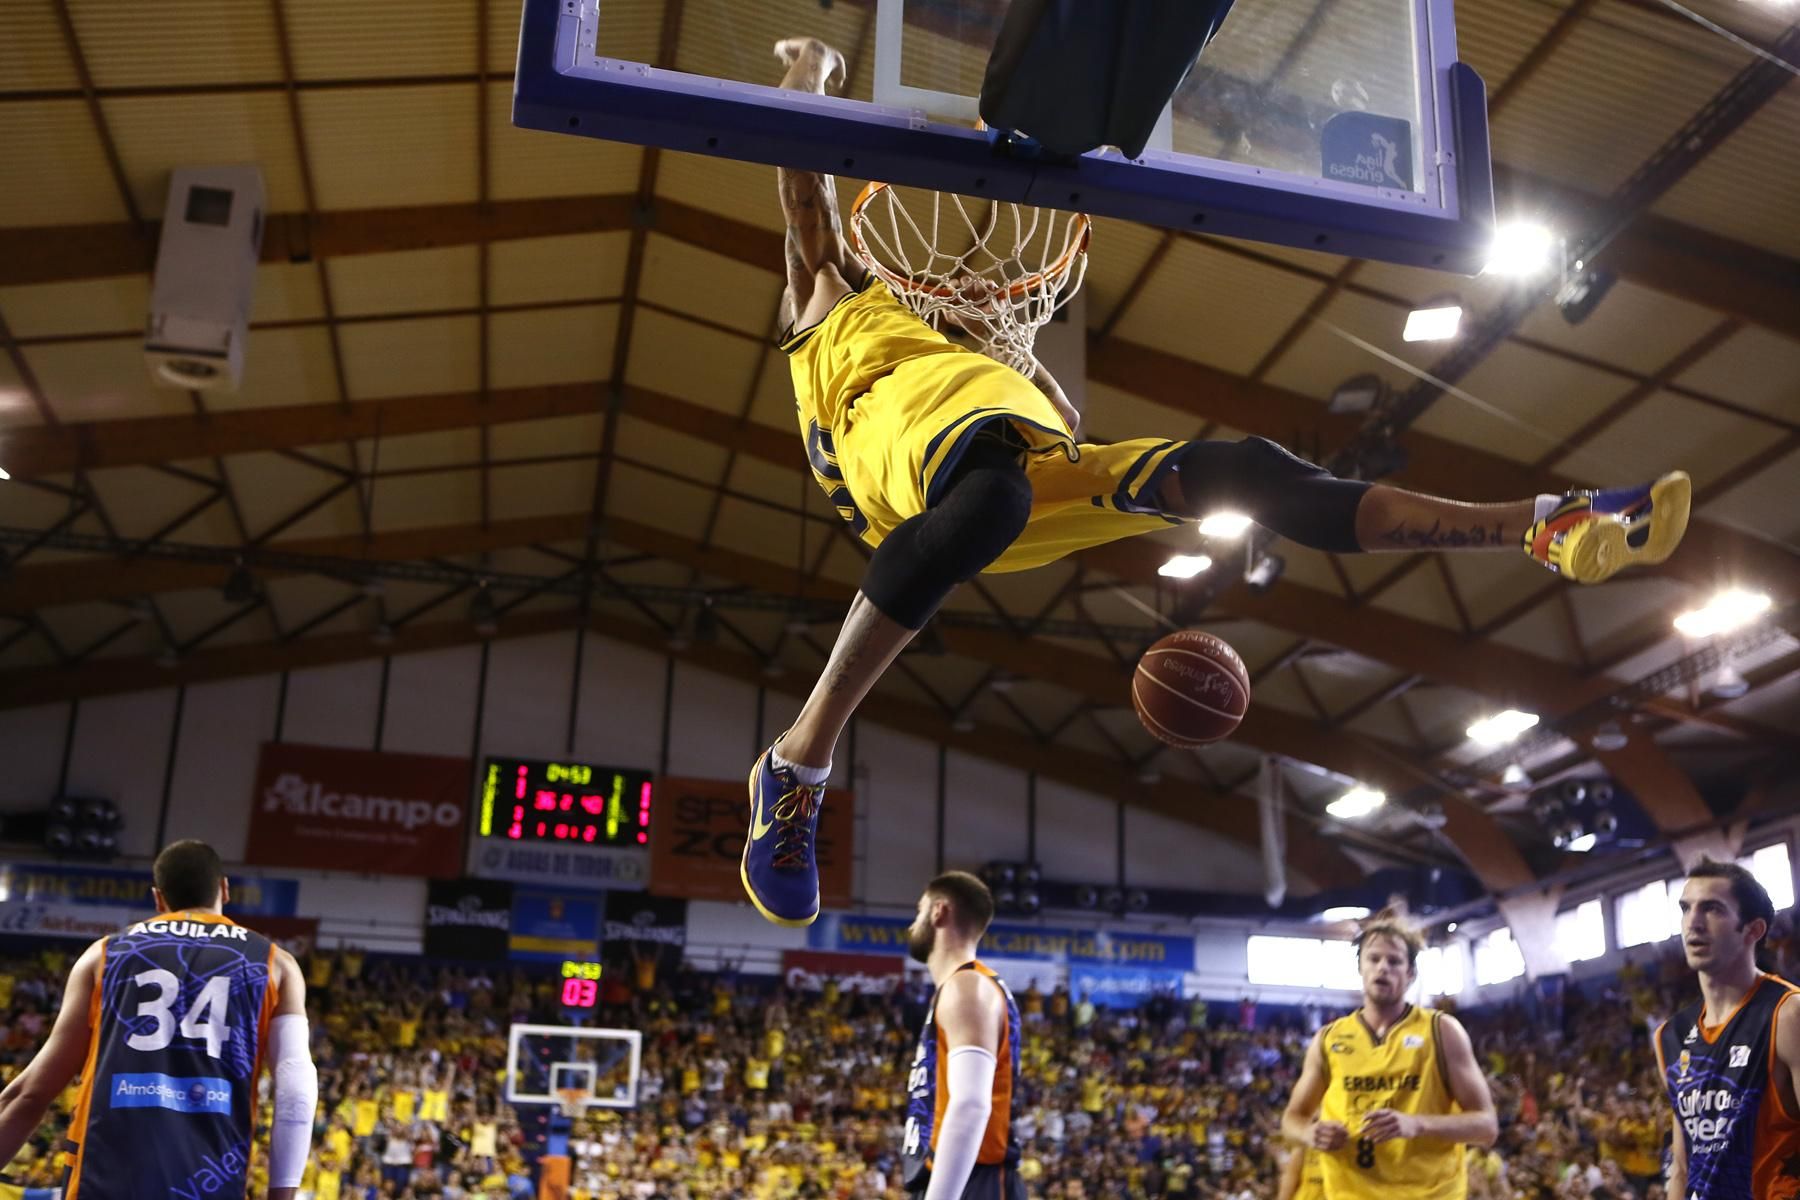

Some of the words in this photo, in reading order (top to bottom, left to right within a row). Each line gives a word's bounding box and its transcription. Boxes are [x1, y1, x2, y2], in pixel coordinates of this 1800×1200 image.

[264, 773, 461, 829] Alcampo
[127, 920, 248, 942] AGUILAR
[561, 978, 598, 1008] 03
[126, 968, 232, 1059] 34
[1356, 1136, 1375, 1169] 8
